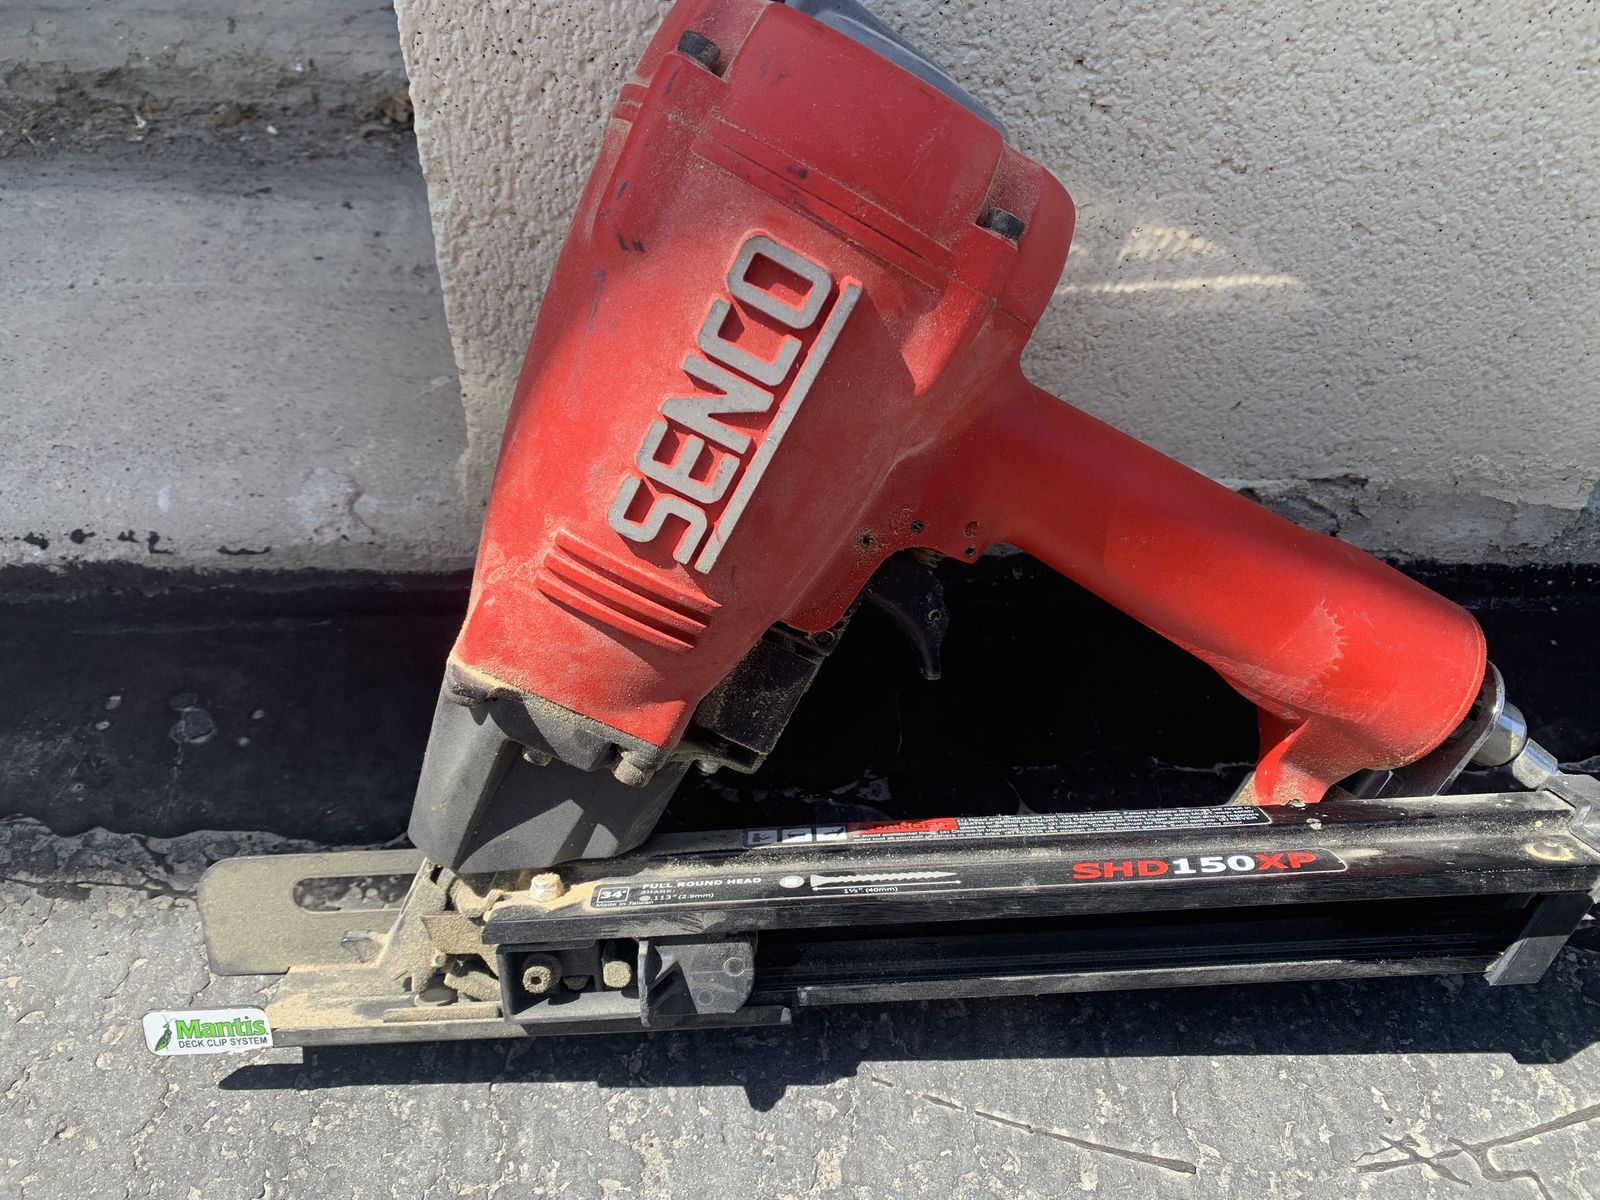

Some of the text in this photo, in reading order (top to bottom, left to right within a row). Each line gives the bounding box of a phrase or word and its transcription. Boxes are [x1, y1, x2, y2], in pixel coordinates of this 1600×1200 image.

[607, 234, 832, 565] SENCO
[1073, 853, 1317, 879] SHD150XP
[677, 879, 723, 887] ROUND
[175, 1016, 267, 1040] Mantis
[178, 1036, 268, 1049] DECK CLIP SYSTEM
